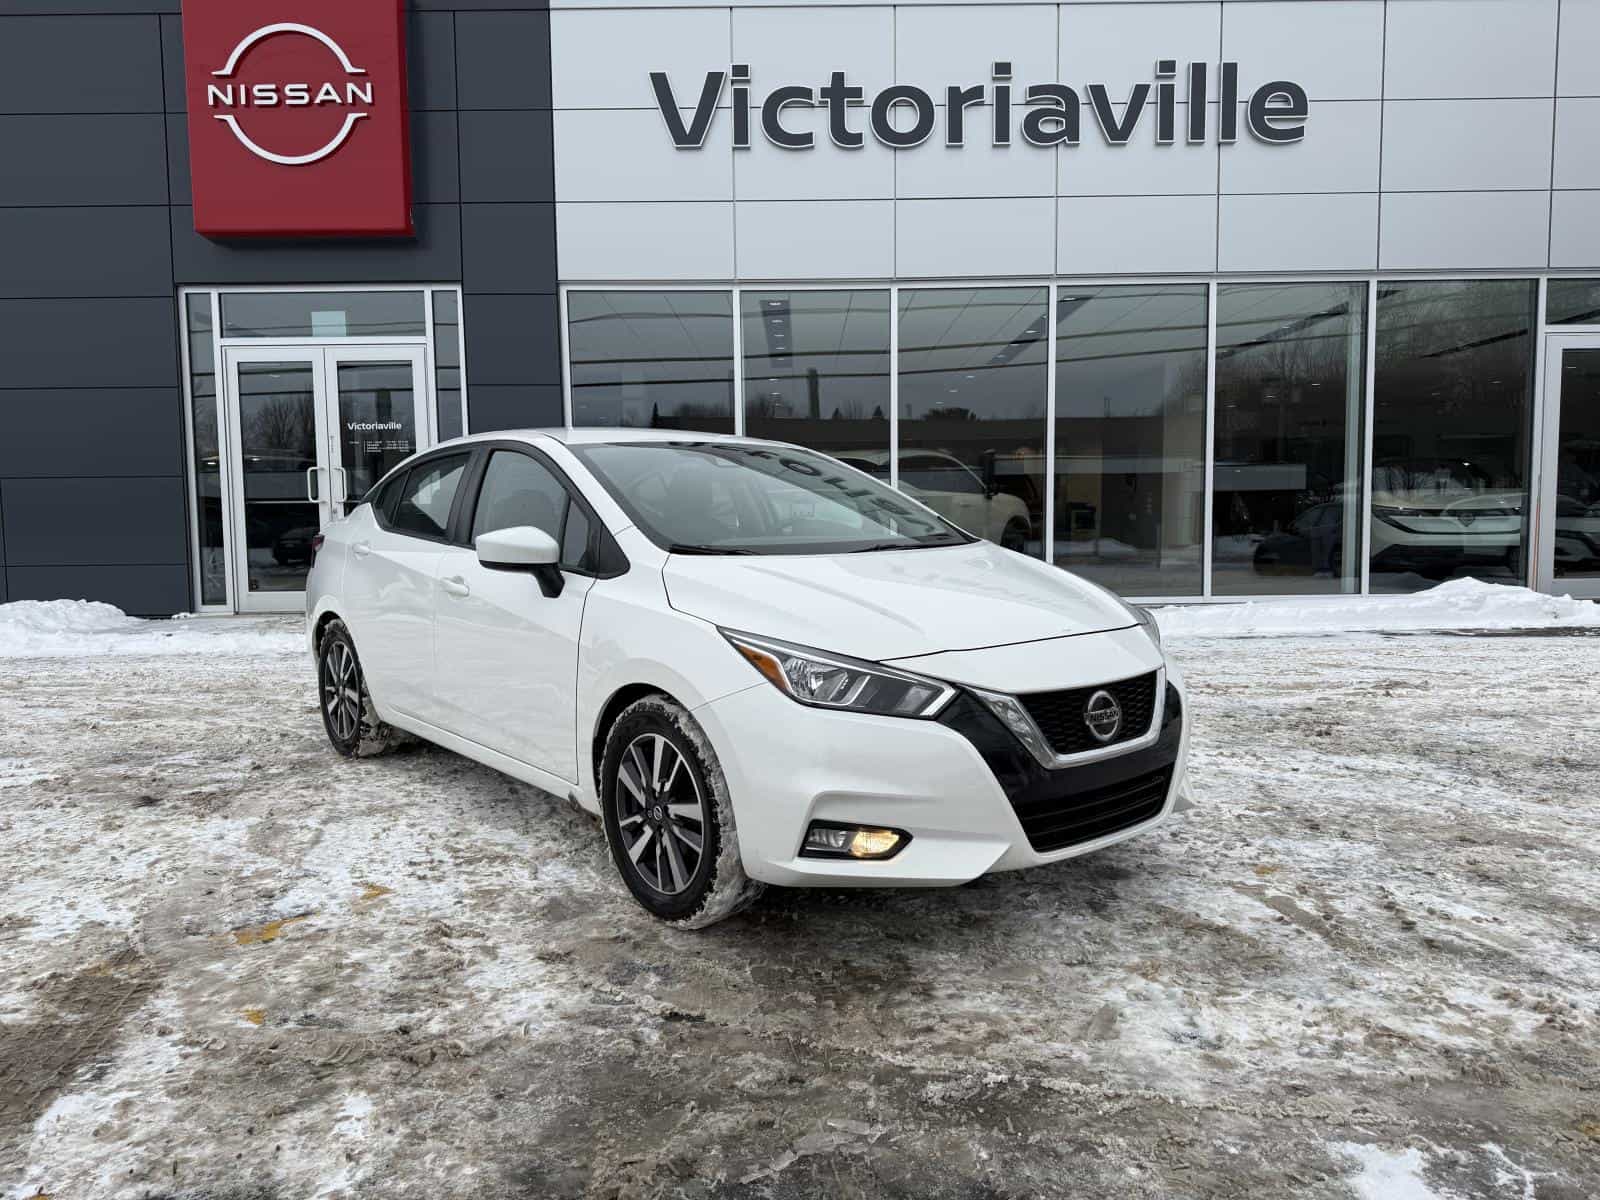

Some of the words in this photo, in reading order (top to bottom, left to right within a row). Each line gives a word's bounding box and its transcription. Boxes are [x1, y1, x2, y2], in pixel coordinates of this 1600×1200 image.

[207, 82, 373, 105] NISSAN
[649, 60, 1310, 150] Victoriaville
[347, 421, 402, 431] Victoriaville
[1088, 708, 1120, 722] NISSAN
